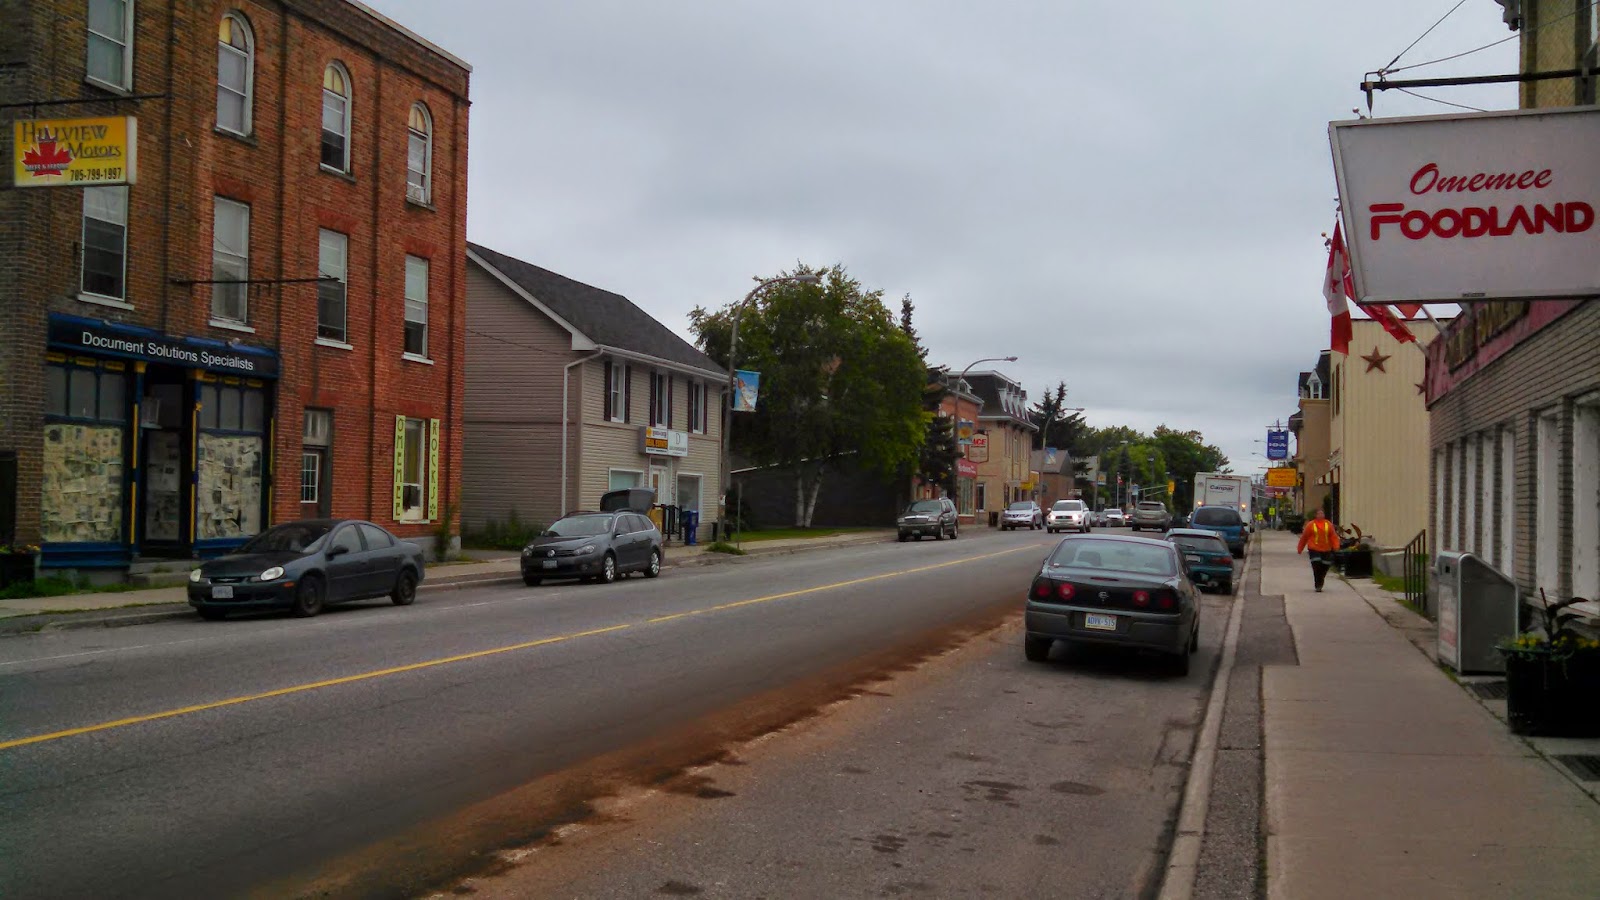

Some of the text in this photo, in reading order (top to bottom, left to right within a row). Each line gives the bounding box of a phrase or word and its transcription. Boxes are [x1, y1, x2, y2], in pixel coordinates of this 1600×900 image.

[70, 167, 122, 181] 705-799-1997
[1409, 162, 1552, 195] Omemee
[1369, 202, 1595, 240] FOODLAND
[82, 331, 254, 371] Document Solutions Specialists
